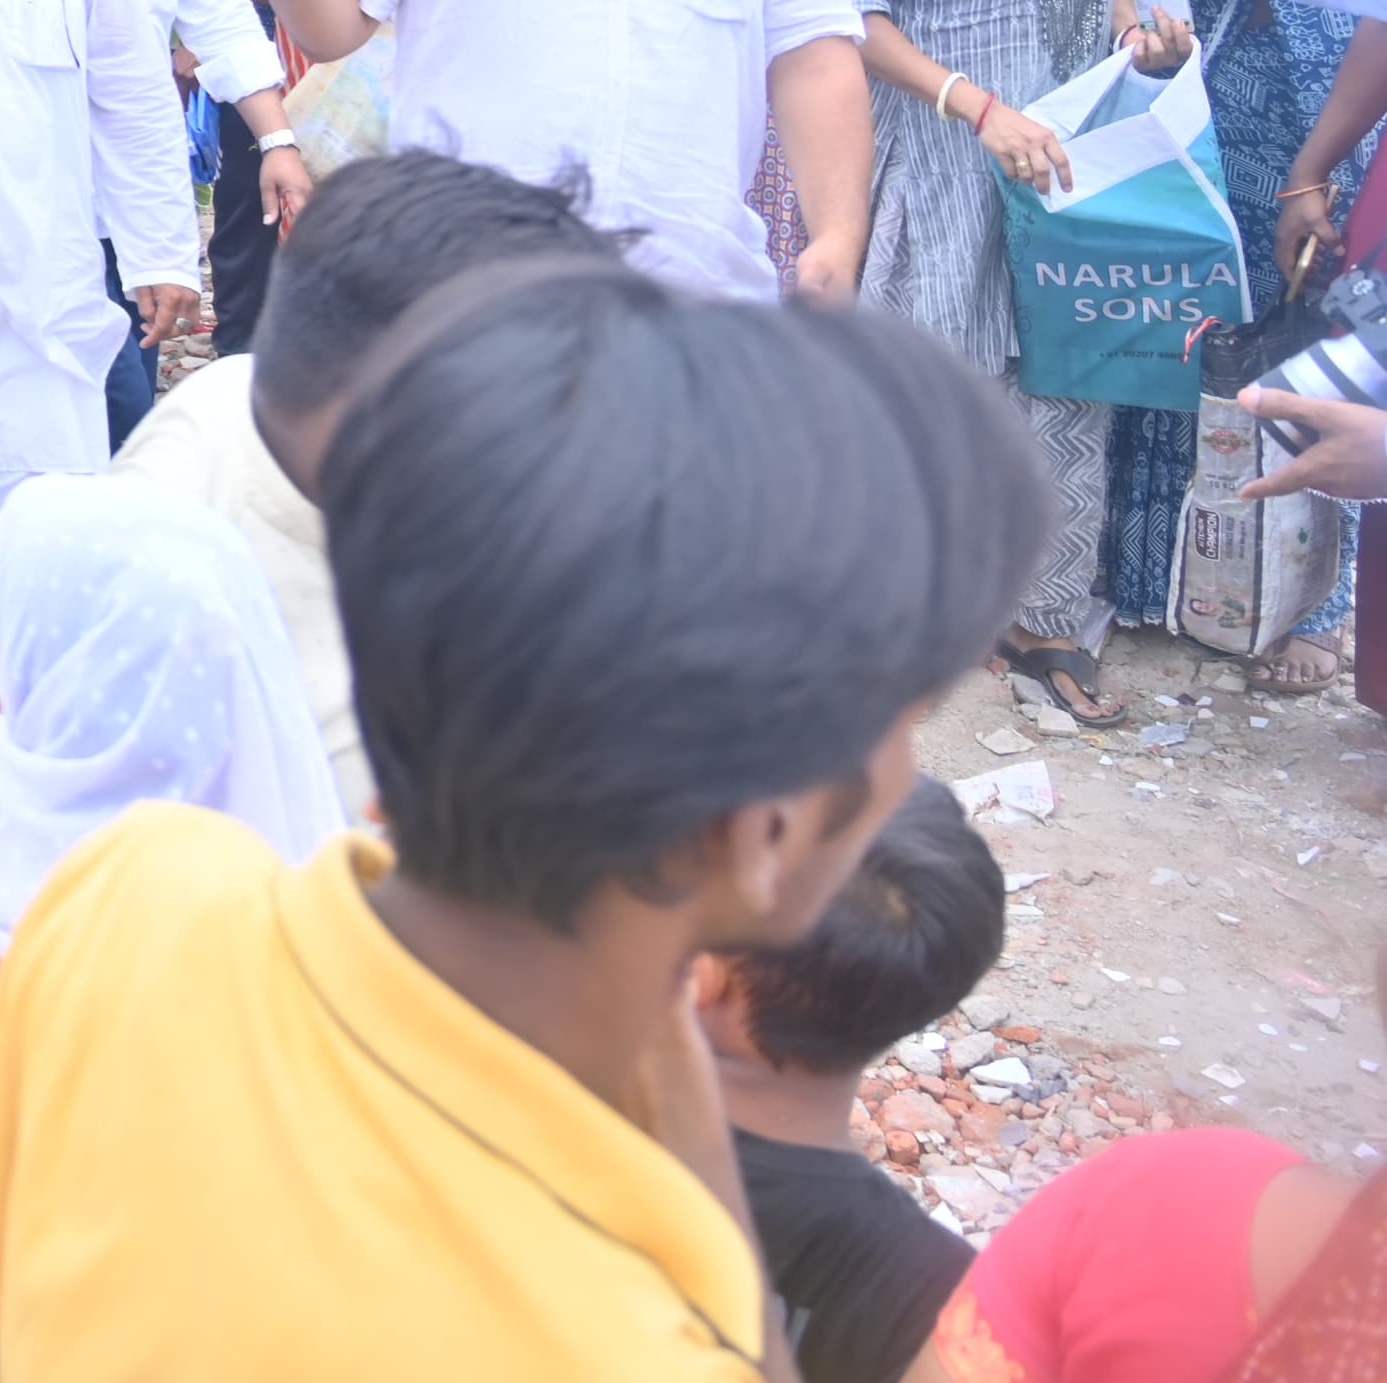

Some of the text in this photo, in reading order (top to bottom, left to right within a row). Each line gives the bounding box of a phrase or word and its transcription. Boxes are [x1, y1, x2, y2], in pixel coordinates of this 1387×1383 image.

[1035, 261, 1237, 289] NARULA
[1074, 296, 1204, 324] SONS
[1206, 511, 1217, 559] CHAMPION
